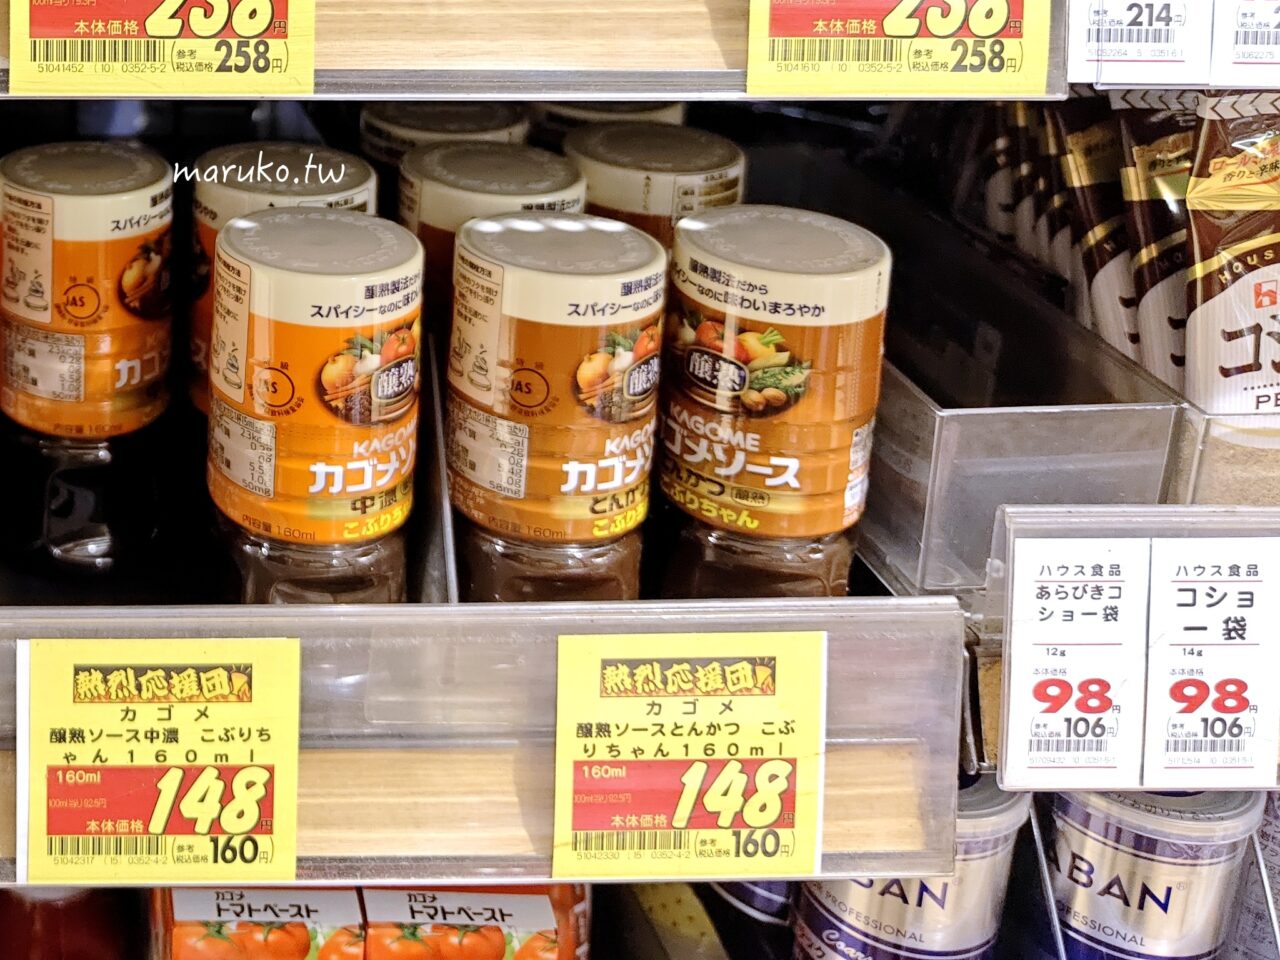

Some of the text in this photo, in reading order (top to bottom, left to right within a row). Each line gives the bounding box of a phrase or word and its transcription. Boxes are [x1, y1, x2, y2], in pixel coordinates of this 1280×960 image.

[74, 20, 139, 35] 本体価格
[813, 19, 877, 34] 本体価格
[1039, 564, 1122, 578] ハウス食品
[1176, 564, 1259, 578] ハウス食品
[1036, 585, 1122, 601] あらびきコ
[1176, 587, 1255, 609] コショ
[1038, 606, 1119, 623] ショー袋
[120, 704, 210, 722] カゴメ
[647, 699, 734, 715] カゴメ
[56, 770, 101, 784] 160ml
[583, 766, 626, 779] 160ml
[86, 820, 144, 833] 本体価格
[611, 815, 667, 828] 本体価格
[216, 903, 318, 919] トマトペースト
[410, 904, 513, 923] トマトペースト
